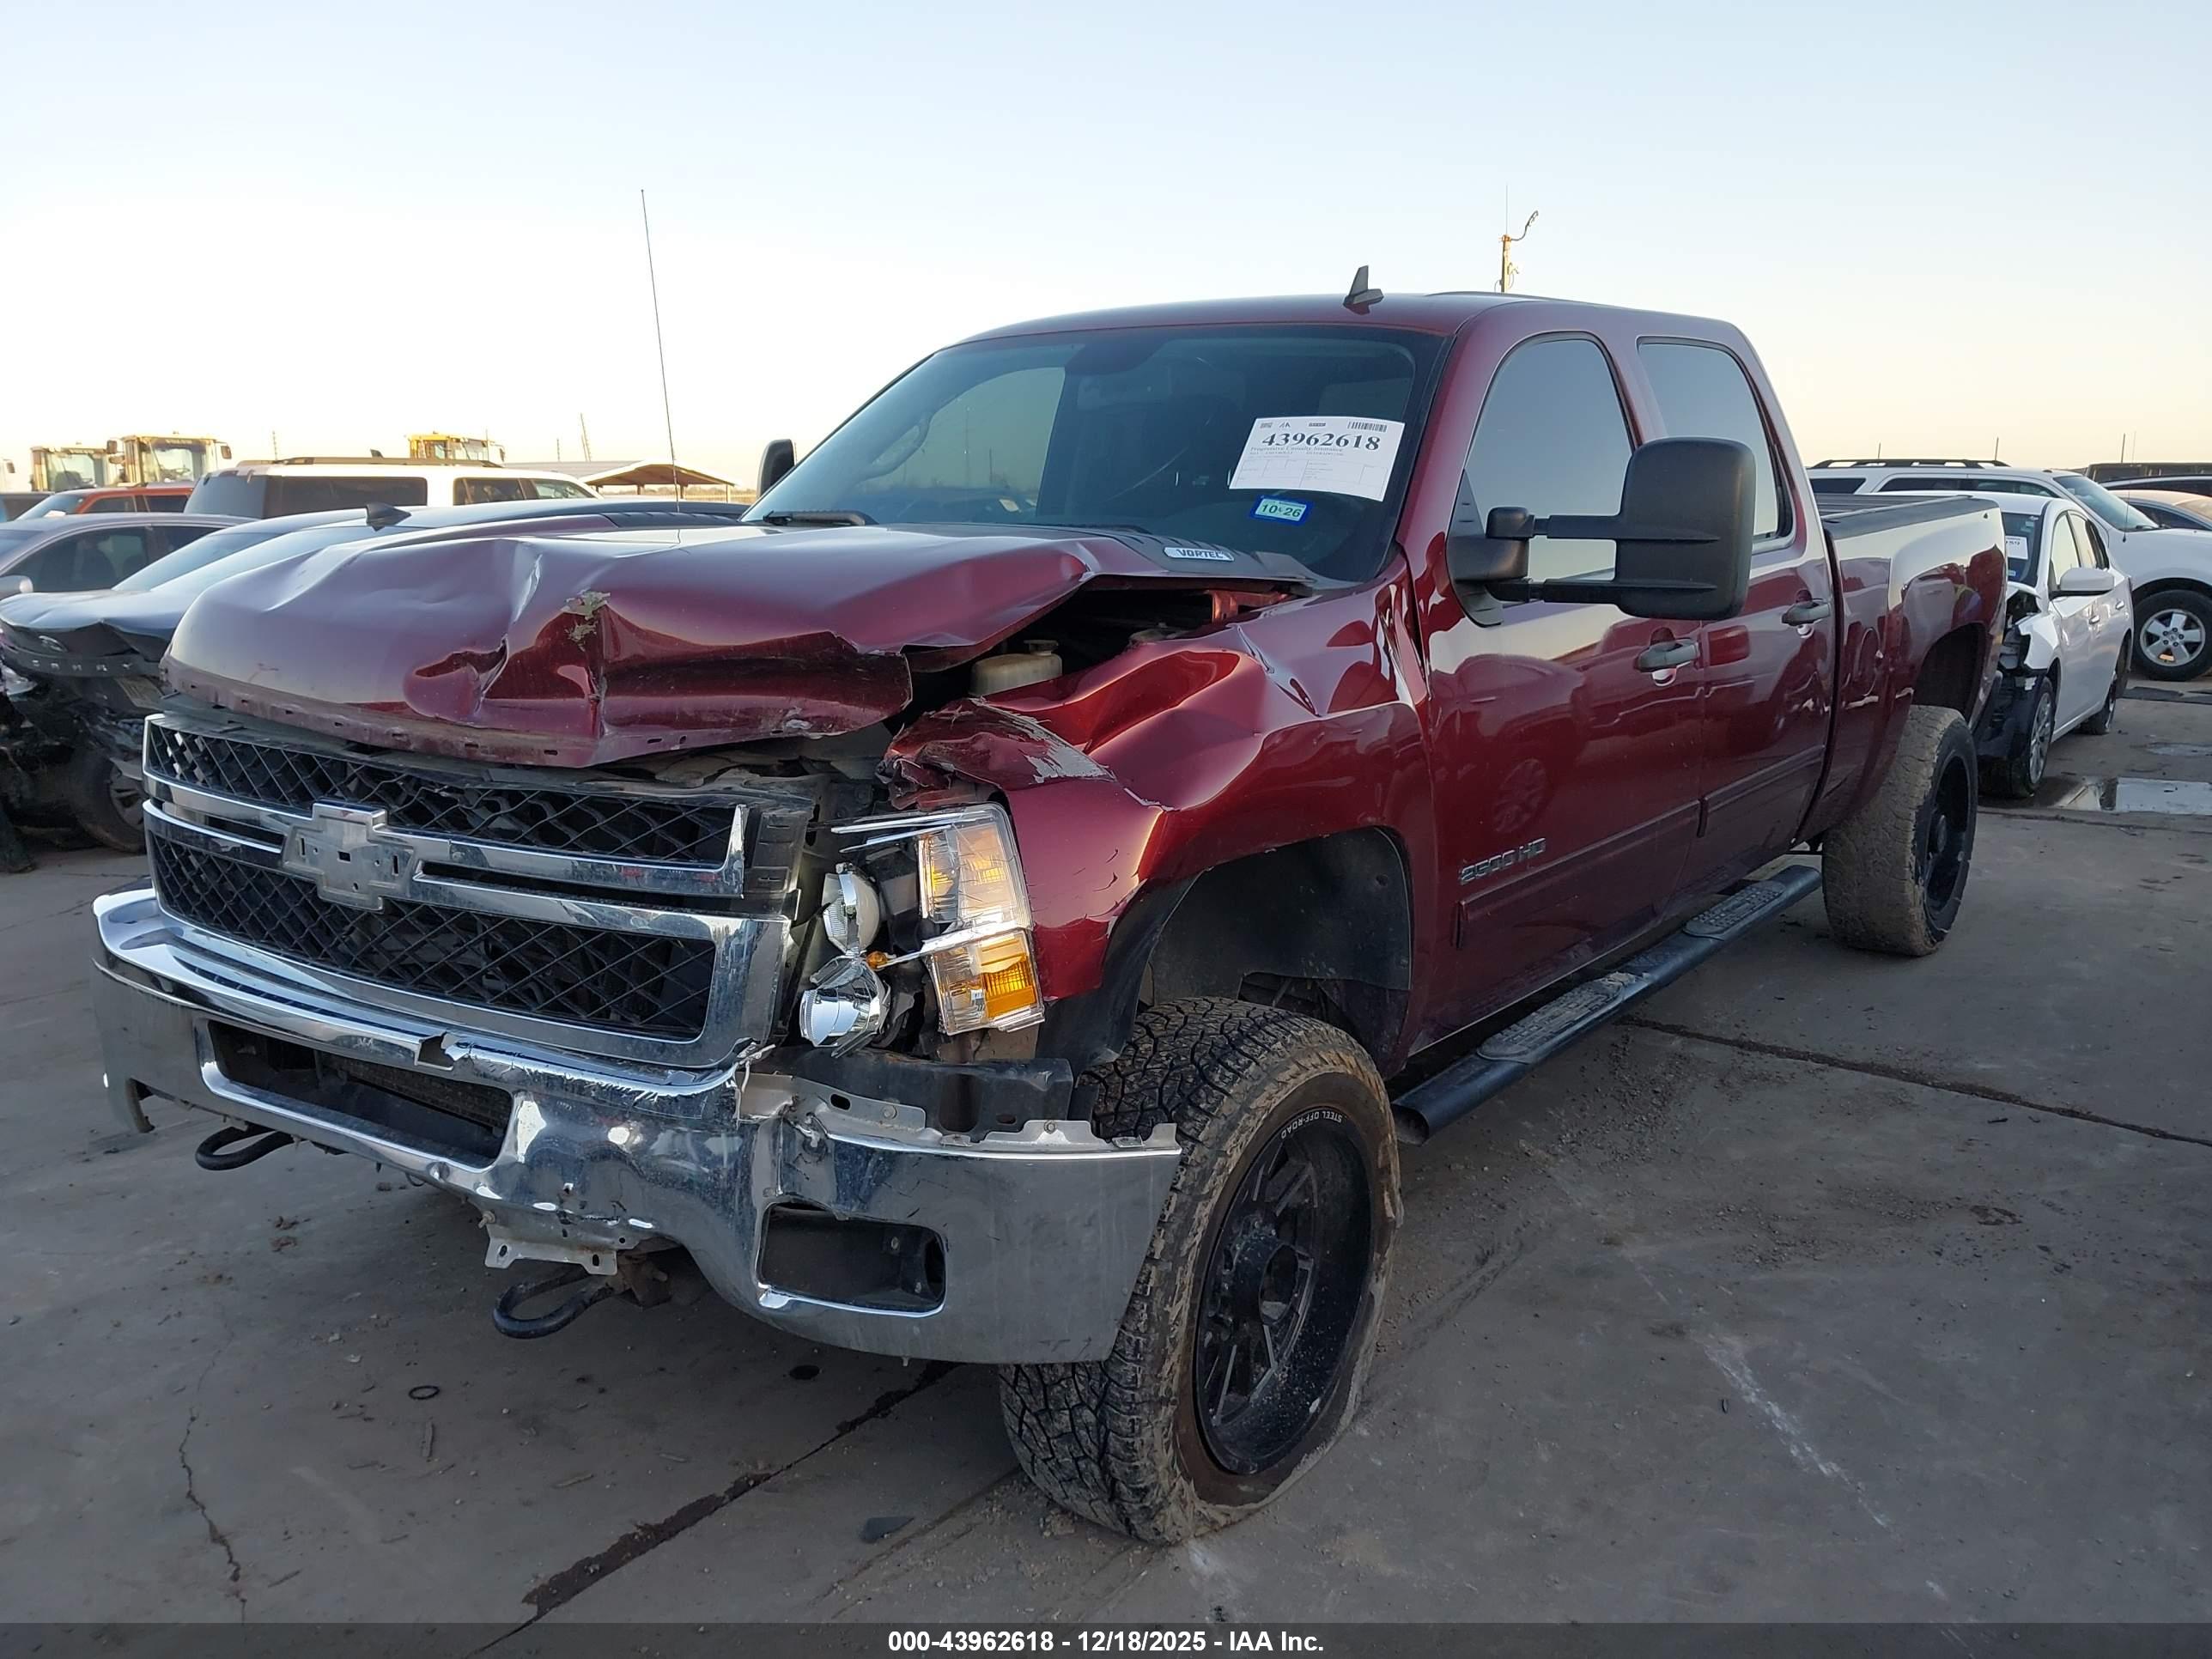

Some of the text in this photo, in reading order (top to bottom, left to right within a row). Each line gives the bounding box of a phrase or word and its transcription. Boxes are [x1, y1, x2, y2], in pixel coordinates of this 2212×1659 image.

[1261, 432, 1381, 451] 43962618
[1261, 504, 1302, 517] 10 26
[1176, 549, 1224, 558] VORTEC
[1322, 1110, 1343, 1123] STEEL
